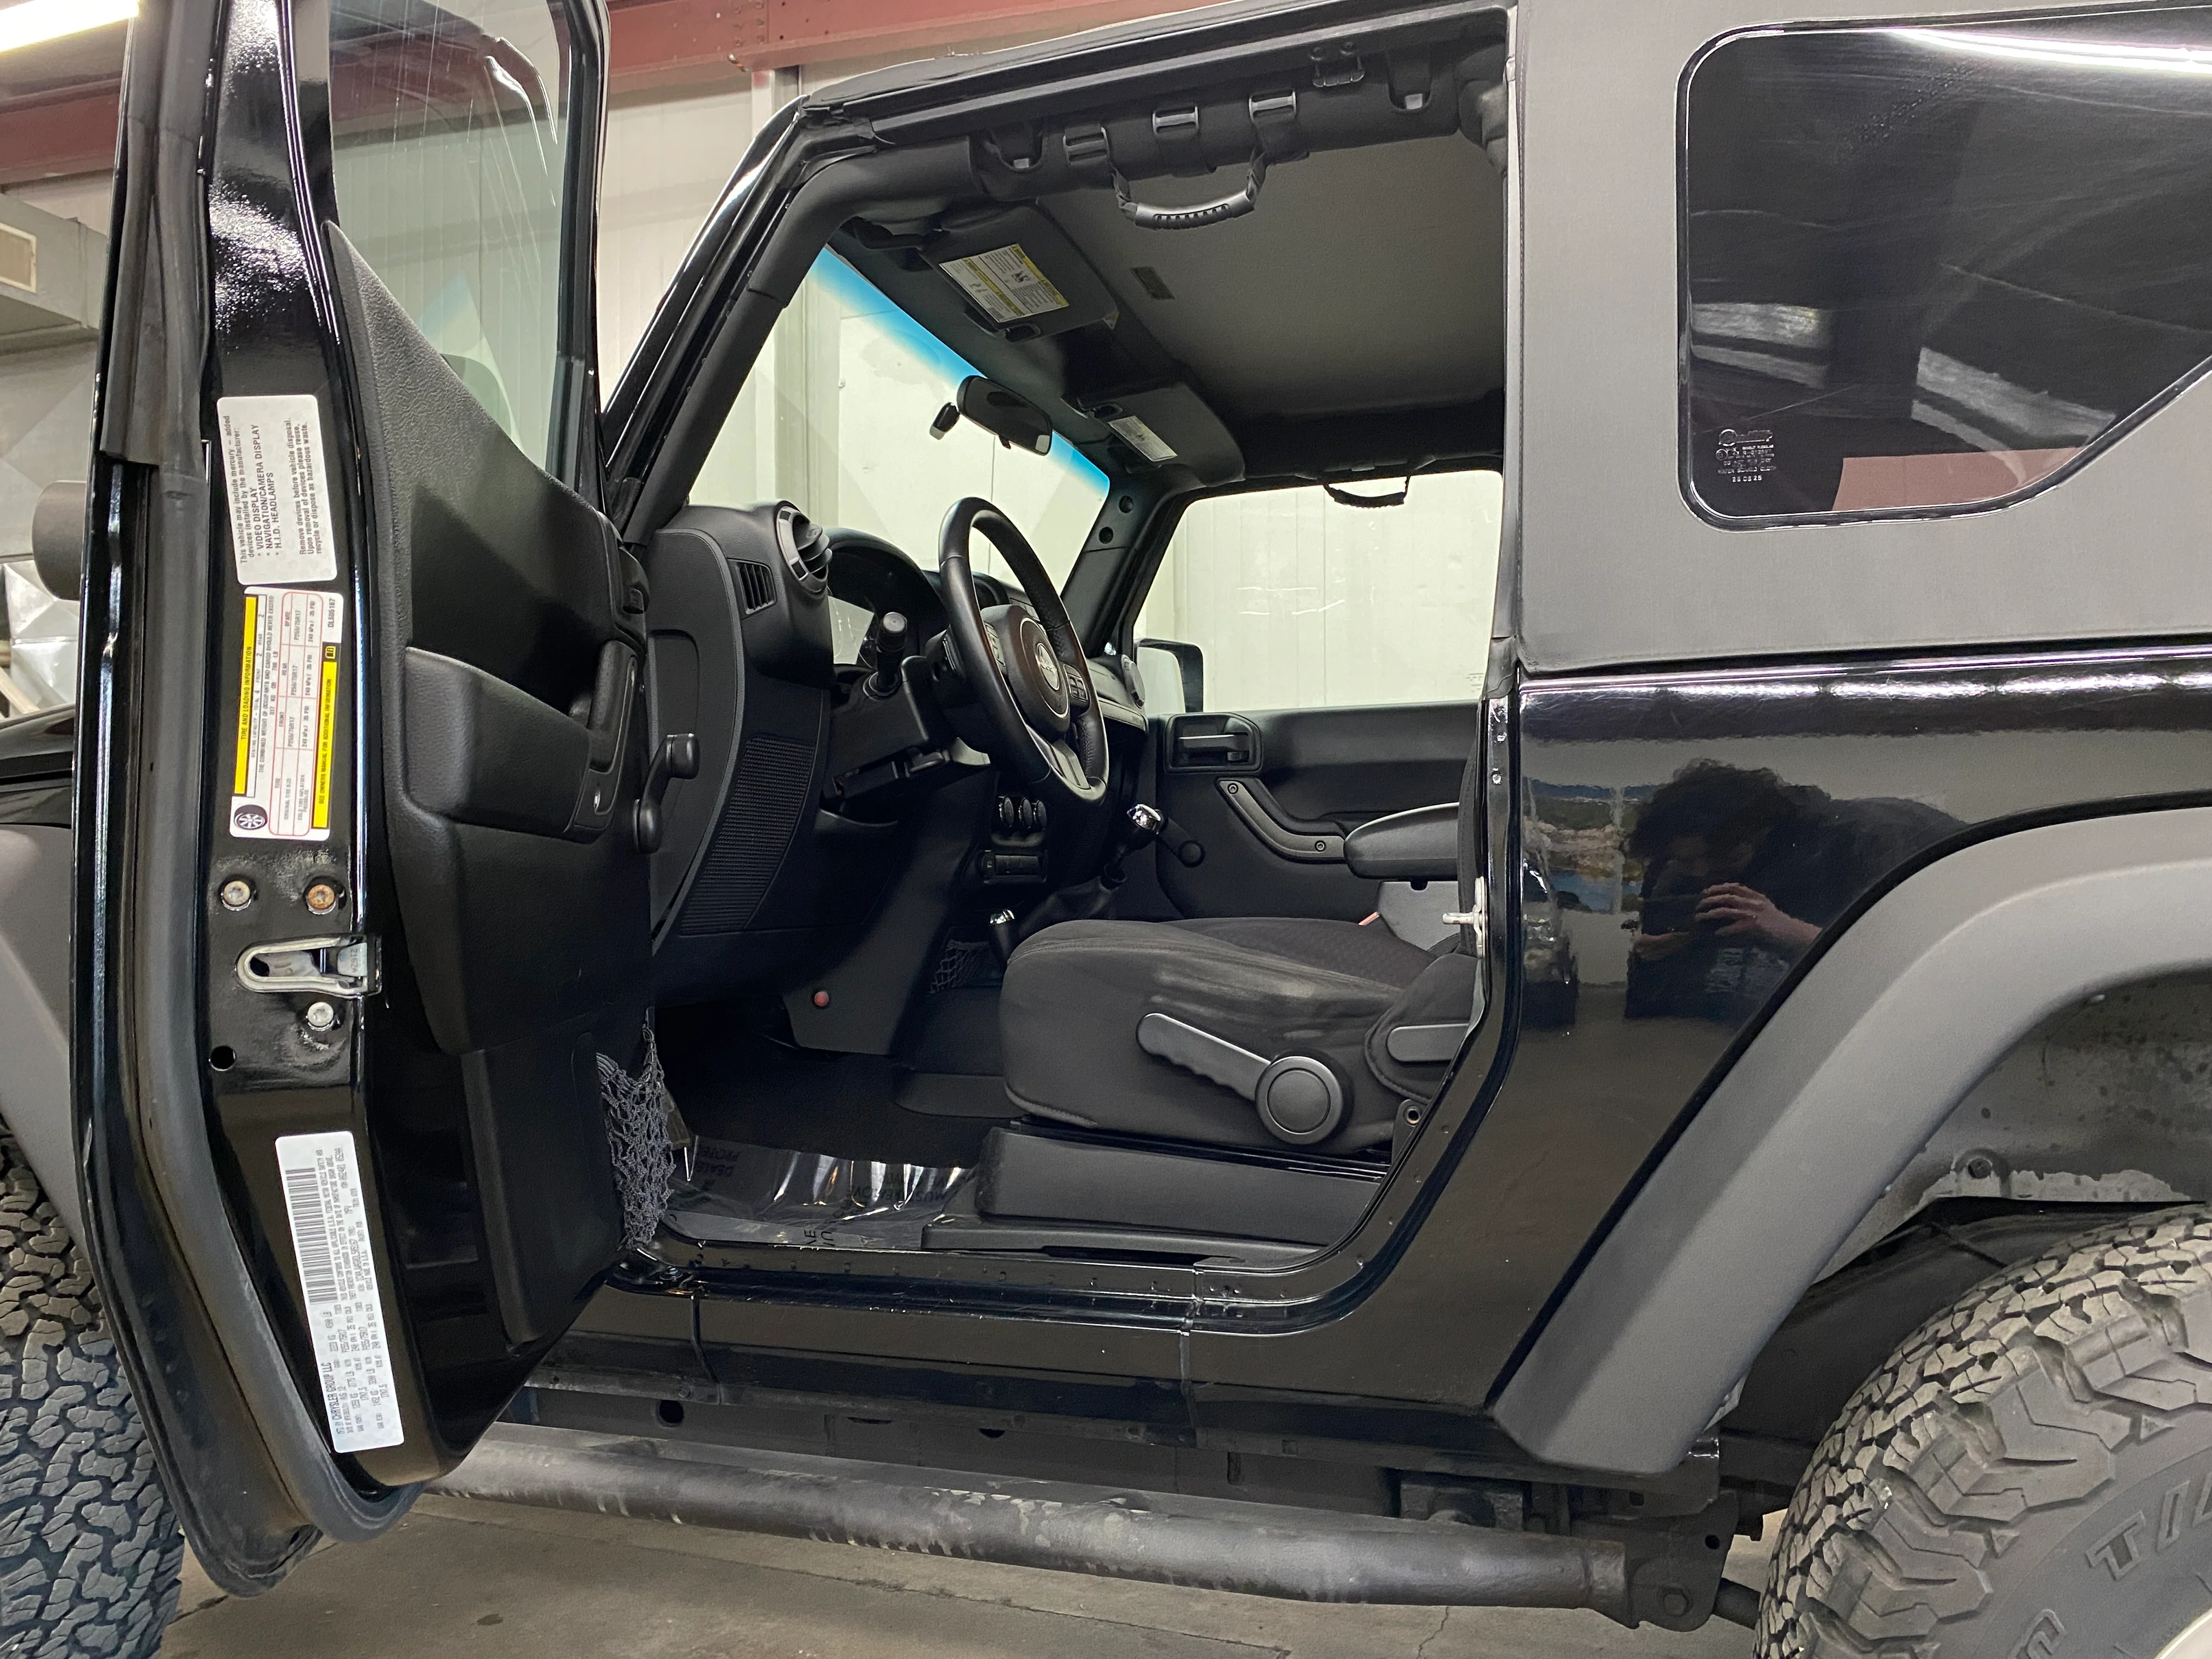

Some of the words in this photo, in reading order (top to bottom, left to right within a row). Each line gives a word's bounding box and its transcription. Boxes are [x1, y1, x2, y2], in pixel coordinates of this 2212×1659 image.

[223, 415, 232, 436] added
[283, 417, 295, 448] disposal.
[251, 424, 262, 459] DISPLAY
[228, 448, 238, 476] mercury
[287, 450, 297, 474] vehicle
[295, 447, 305, 469] please
[303, 447, 313, 481] hazardous
[230, 479, 240, 503] include
[291, 477, 300, 498] before
[298, 471, 307, 496] devices
[250, 487, 260, 521] DISPLAY
[256, 461, 273, 549] NAVIGATION/CAMERA
[266, 472, 279, 522] HEADLAMPS
[308, 493, 319, 518] dispose
[241, 501, 251, 529] installed
[294, 500, 303, 526] devices
[302, 508, 312, 534] removal
[236, 523, 245, 546] vehicle
[245, 532, 254, 557] devices
[254, 524, 264, 549] VIDEO
[272, 525, 281, 548] H.I.D.
[297, 528, 306, 554] Remove
[306, 537, 315, 554] Upon
[313, 530, 323, 554] recycle
[239, 549, 247, 563] This
[320, 1362, 332, 1372] LLC
[323, 1374, 336, 1392] GROUP
[327, 1393, 342, 1420] CHRYSLER
